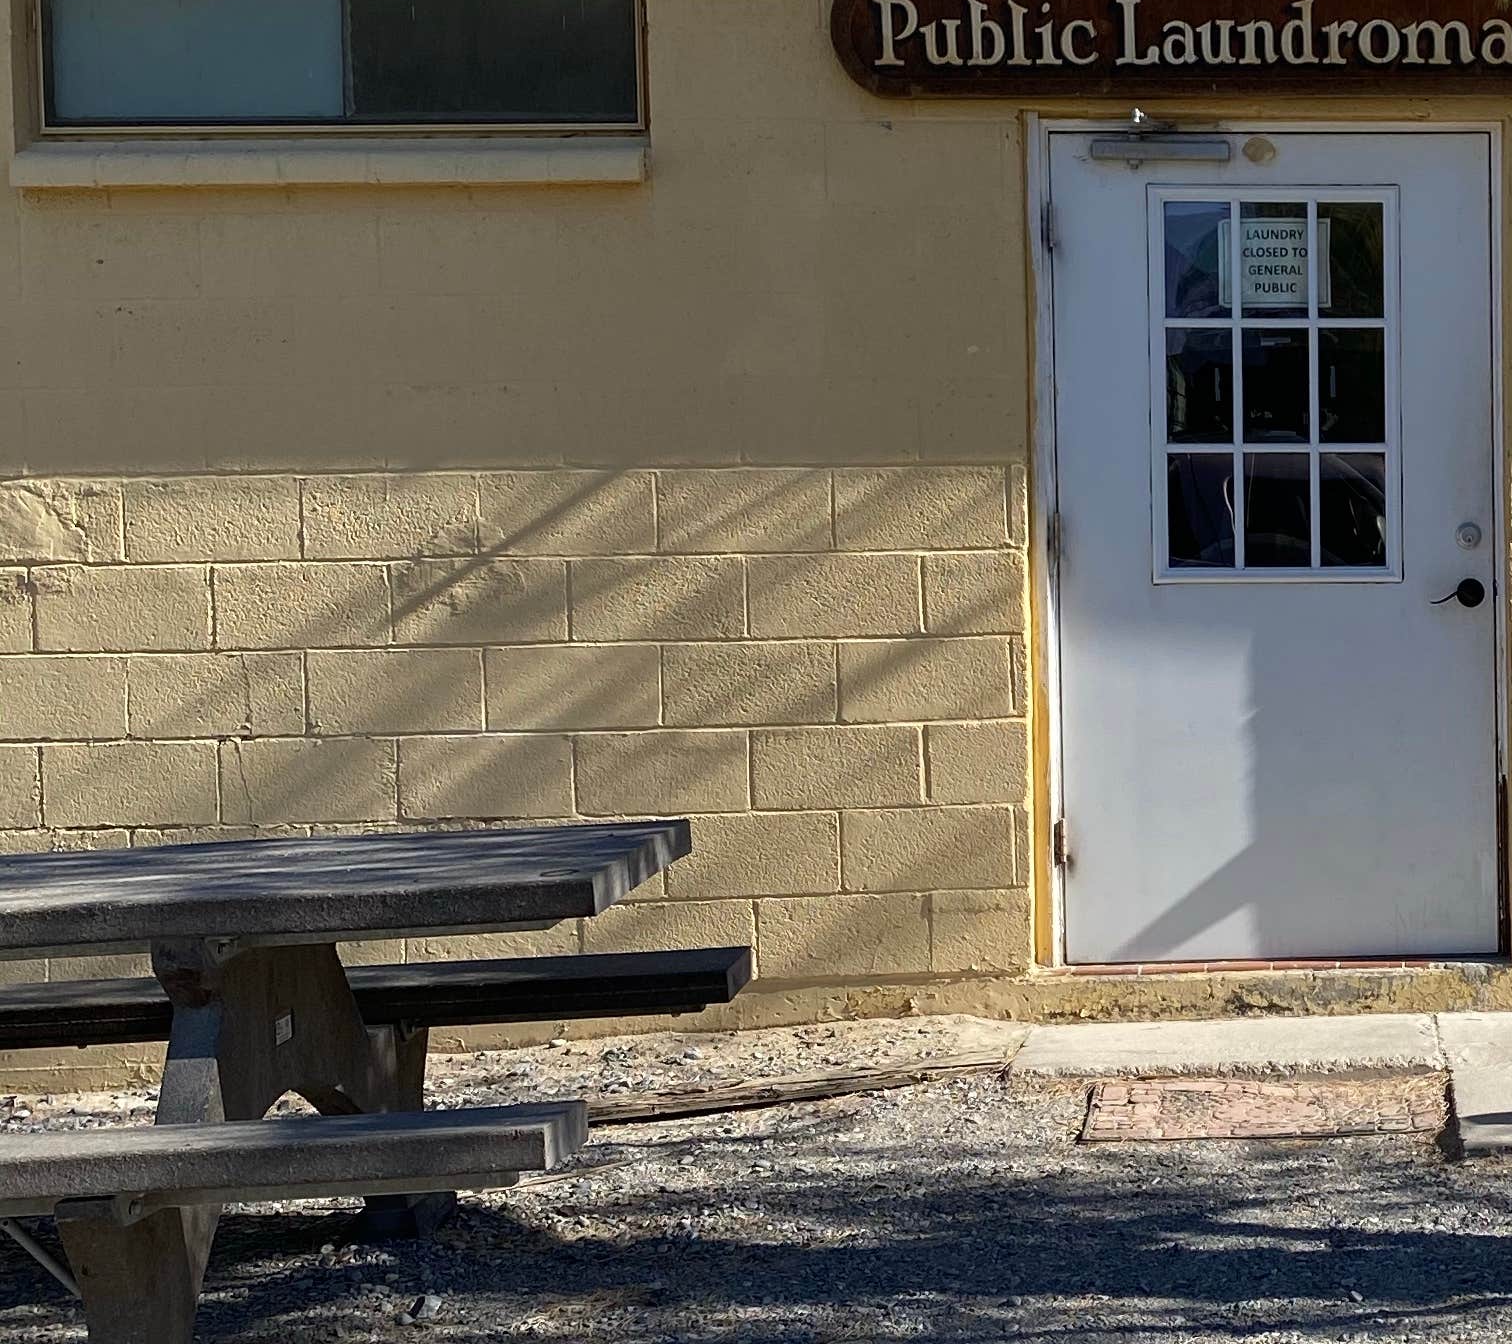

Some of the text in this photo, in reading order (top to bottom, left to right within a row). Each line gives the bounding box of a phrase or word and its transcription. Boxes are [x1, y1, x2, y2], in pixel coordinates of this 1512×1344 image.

[1246, 229, 1304, 240] LAUNDRY
[1242, 248, 1308, 258] CLOSED TO
[1248, 265, 1303, 275] GENERAL
[1255, 283, 1296, 293] PUBLIC
